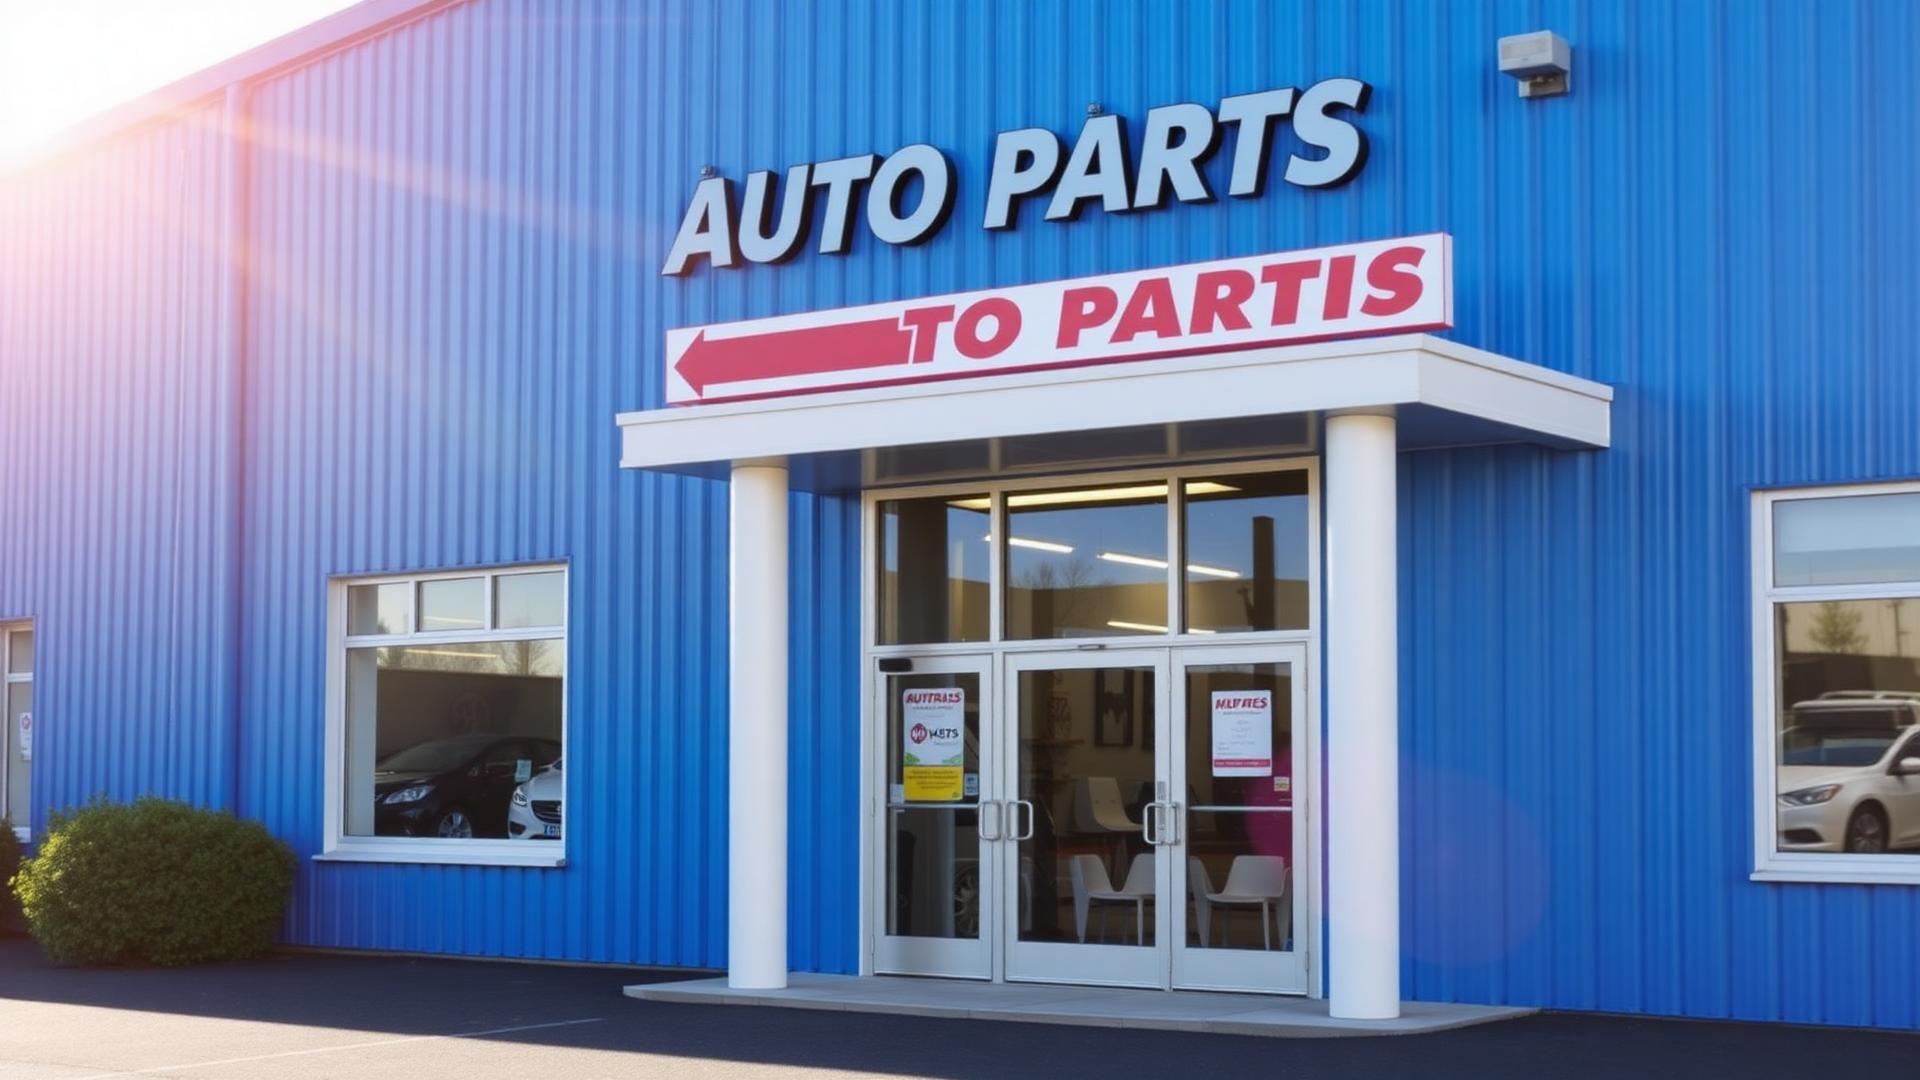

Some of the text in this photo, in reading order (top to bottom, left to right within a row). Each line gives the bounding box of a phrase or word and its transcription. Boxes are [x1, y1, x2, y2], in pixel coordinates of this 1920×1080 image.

[662, 78, 1371, 276] AUTO PARTS
[903, 246, 1424, 364] TO PARTIS
